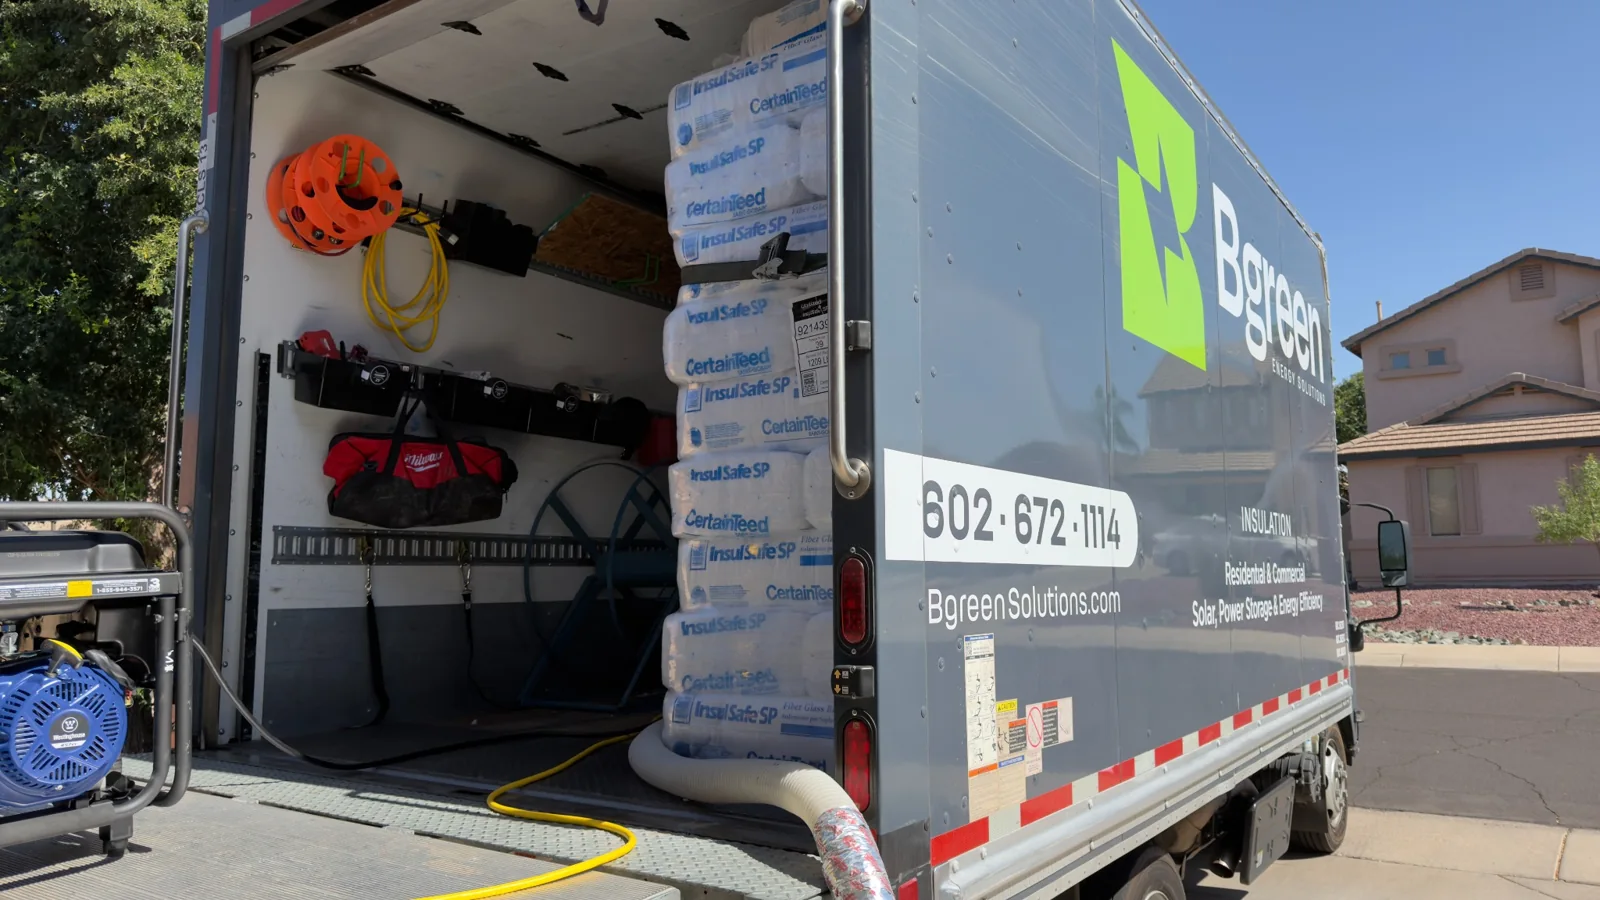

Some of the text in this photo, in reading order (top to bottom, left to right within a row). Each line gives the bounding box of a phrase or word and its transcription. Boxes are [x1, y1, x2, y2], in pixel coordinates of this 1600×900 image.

[760, 53, 779, 72] SP
[749, 77, 827, 114] CertainTeed
[689, 137, 765, 176] InsulSafe SP
[686, 187, 766, 217] CertainTeed
[701, 221, 766, 250] InsulSafe
[768, 215, 787, 233] SP
[1212, 182, 1325, 384] Bgreen
[750, 298, 768, 316] SP
[685, 347, 770, 377] CertainTeed
[705, 376, 790, 403] InsulSafe SP
[1271, 358, 1326, 407] ENERGY SOLUTIONS
[761, 414, 829, 436] CertainTee
[690, 462, 770, 482] InsulSafe SP
[685, 508, 769, 533] CertainTeed
[1241, 506, 1292, 537] INSULATION
[777, 542, 796, 560] SP
[1225, 561, 1306, 586] Residential & Commercial
[766, 584, 834, 602] CertainTee
[927, 585, 1121, 631] BgreenSolutions.com
[1192, 591, 1323, 629] Solar, Power Storage & Energy Efficiency
[681, 612, 766, 636] InsulSafe SP
[694, 701, 778, 725] InsulSafe SP
